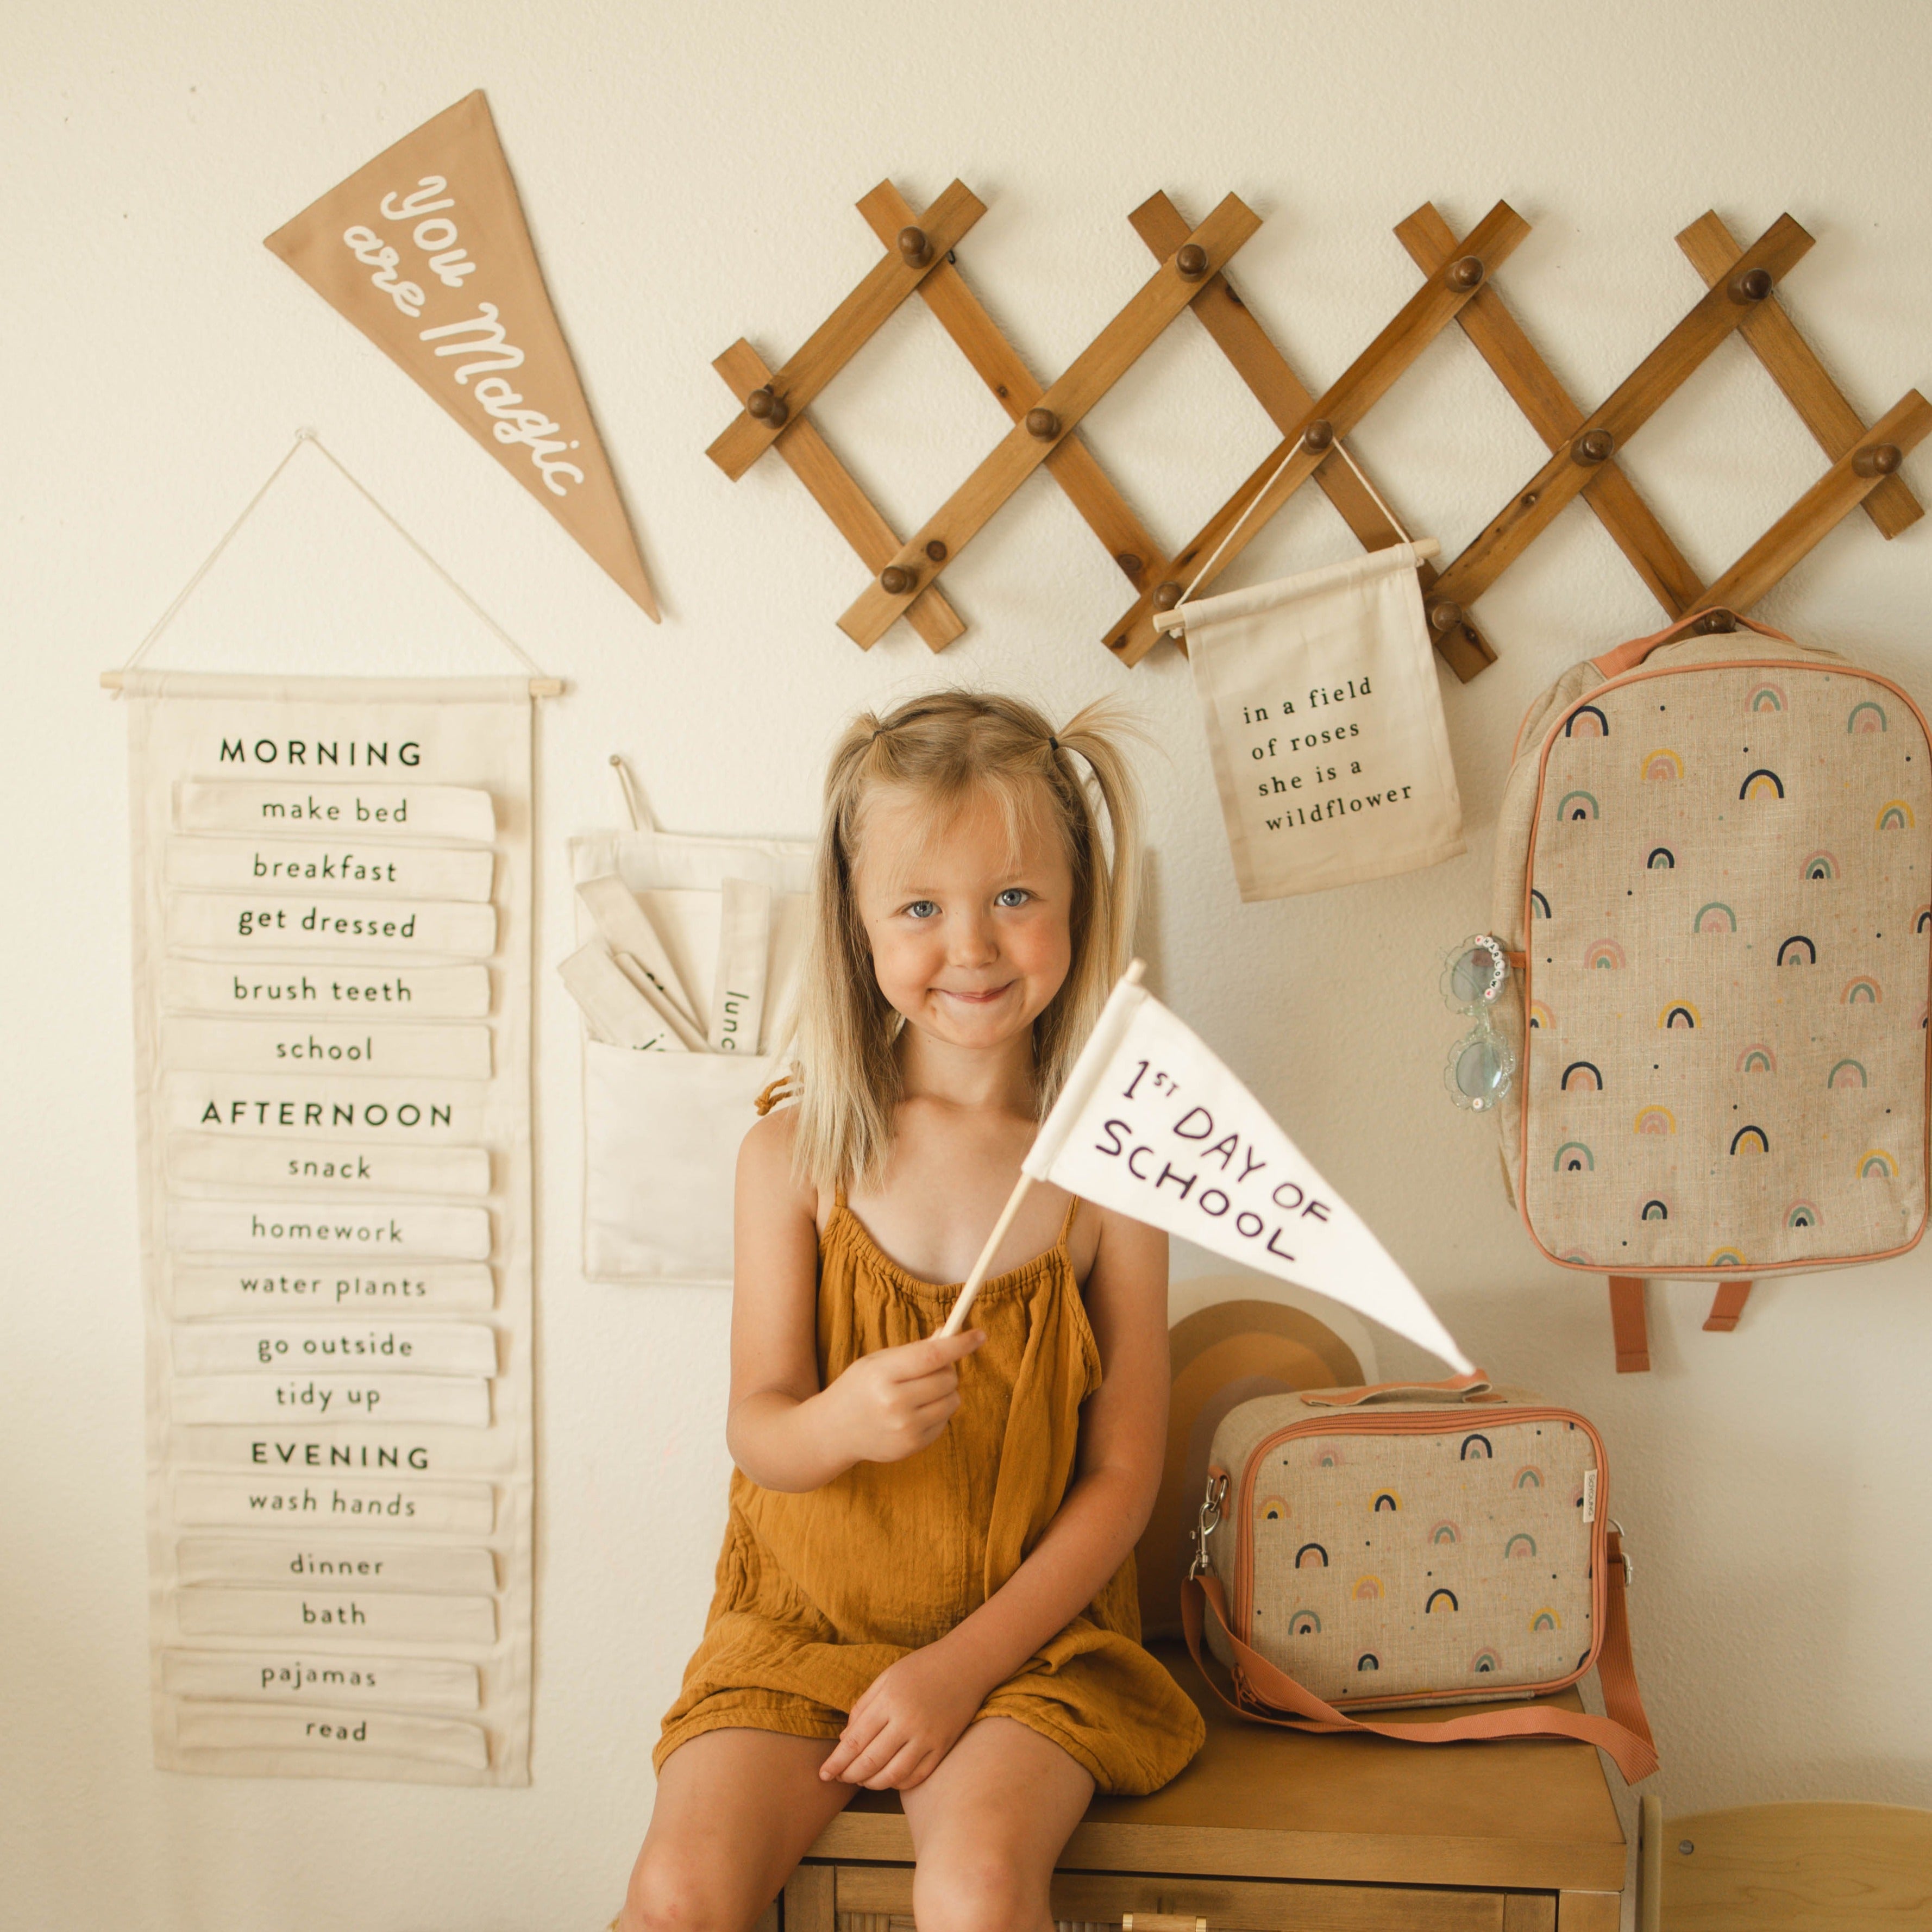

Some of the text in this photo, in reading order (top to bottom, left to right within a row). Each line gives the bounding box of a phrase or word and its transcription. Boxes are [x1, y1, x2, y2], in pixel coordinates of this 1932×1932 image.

[343, 224, 426, 318] are
[419, 302, 585, 496] Magic
[1244, 676, 1372, 724] in a field
[220, 739, 420, 767] MORNING
[1252, 724, 1359, 760] of roses
[1258, 761, 1362, 796] she is a
[262, 796, 406, 823] make bed
[1265, 784, 1412, 831] wildflower
[254, 853, 396, 882] breakfast
[239, 907, 416, 938] get dressed
[1484, 939, 1501, 987] HARLOW
[234, 976, 411, 1001] brush teeth
[720, 990, 750, 1051] lunc
[277, 1036, 372, 1061] school
[202, 1101, 451, 1126] AFTERNOON
[289, 1156, 369, 1178] snack
[1172, 1106, 1266, 1183] DAY
[1272, 1182, 1333, 1224] OF
[1095, 1119, 1297, 1262] SCHOOL
[252, 1215, 402, 1242] homework
[241, 1276, 425, 1303] water plants
[258, 1333, 412, 1363] go outside
[277, 1383, 380, 1412] tidy up
[252, 1442, 428, 1470] EVENING
[249, 1489, 415, 1516] wash hands
[290, 1553, 382, 1575] dinner
[302, 1602, 365, 1624] bath
[261, 1662, 375, 1690] pajamas
[306, 1721, 366, 1741] read
